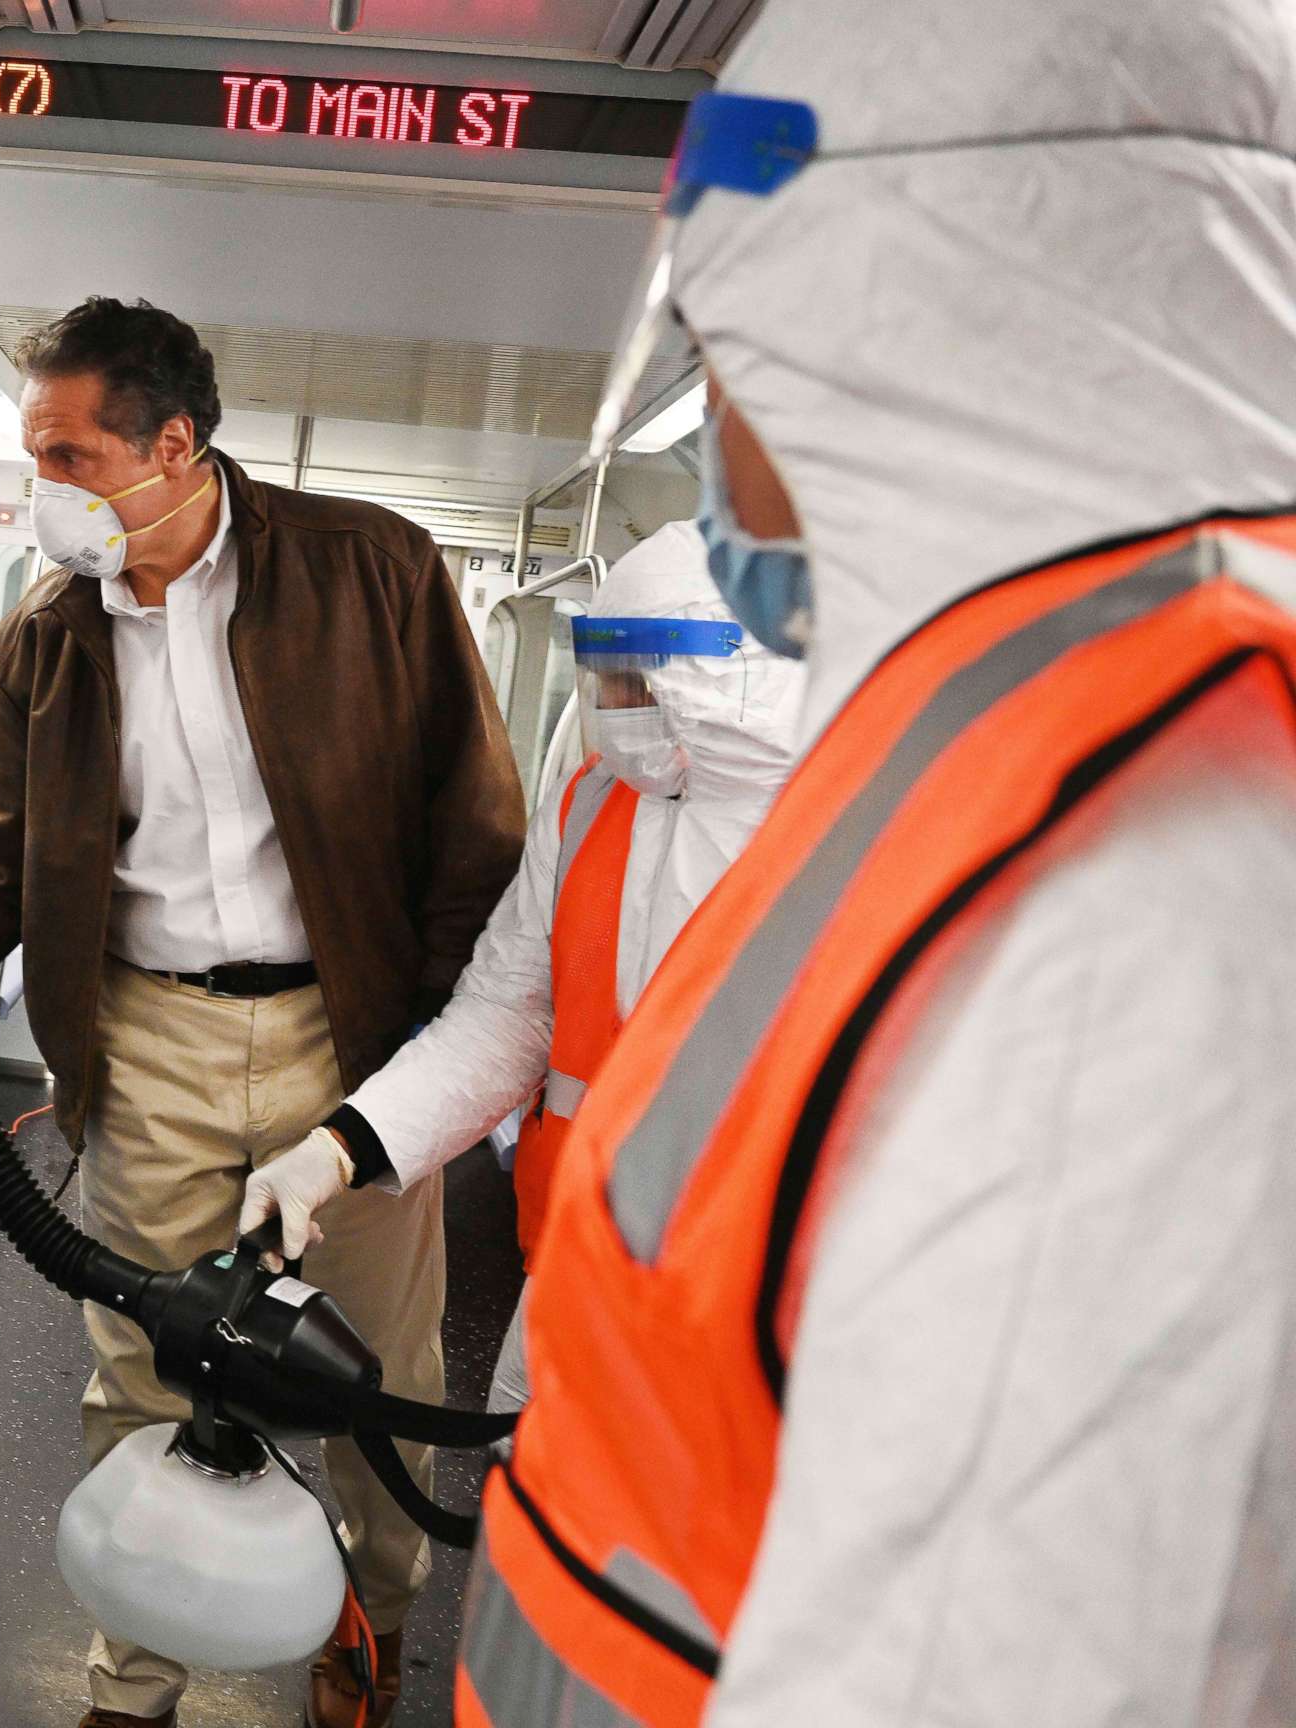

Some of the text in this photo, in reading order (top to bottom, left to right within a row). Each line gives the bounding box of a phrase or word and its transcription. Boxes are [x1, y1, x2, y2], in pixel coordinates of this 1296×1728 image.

[222, 76, 288, 132] TO
[309, 82, 435, 143] MAIN
[456, 92, 530, 149] ST
[470, 558, 482, 571] 2
